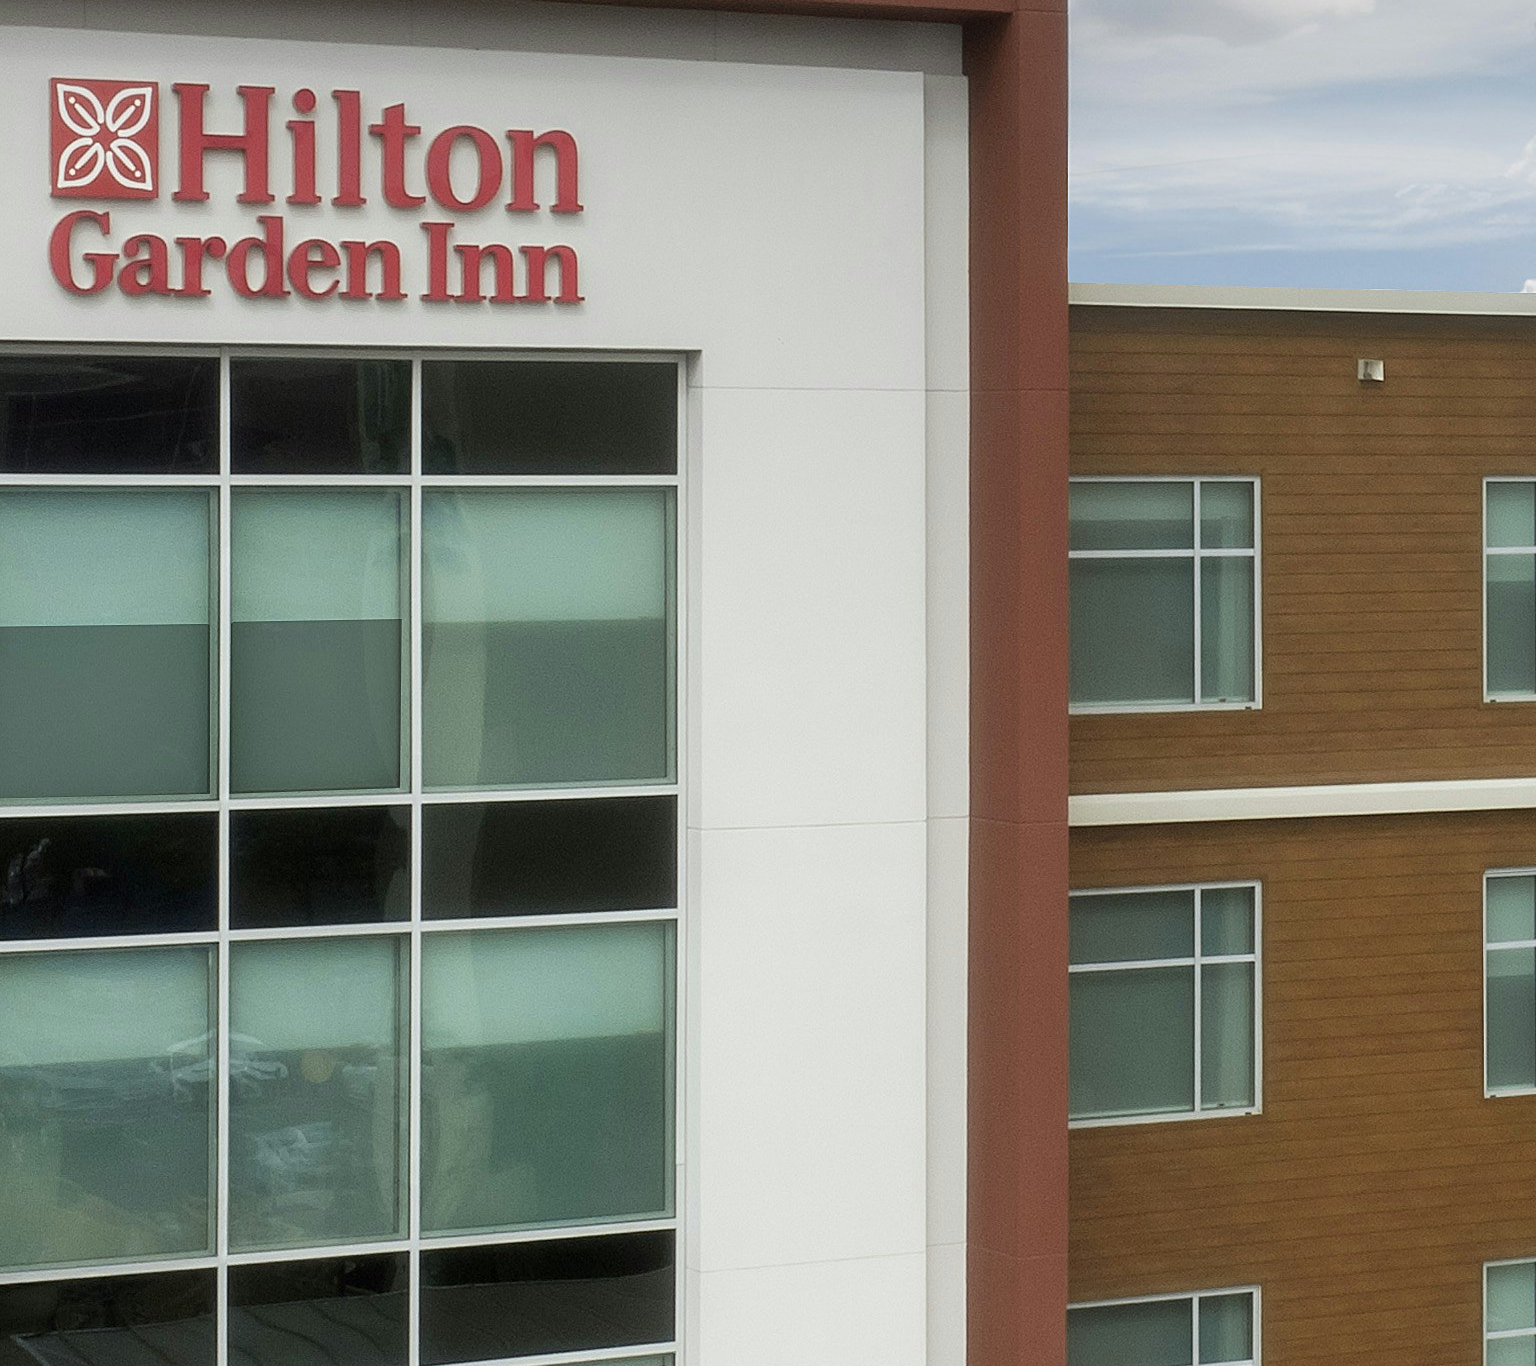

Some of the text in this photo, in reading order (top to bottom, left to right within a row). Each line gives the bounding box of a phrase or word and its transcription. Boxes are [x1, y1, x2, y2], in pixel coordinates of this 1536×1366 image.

[172, 82, 584, 213] Hilton
[49, 210, 585, 303] Garden Inn
